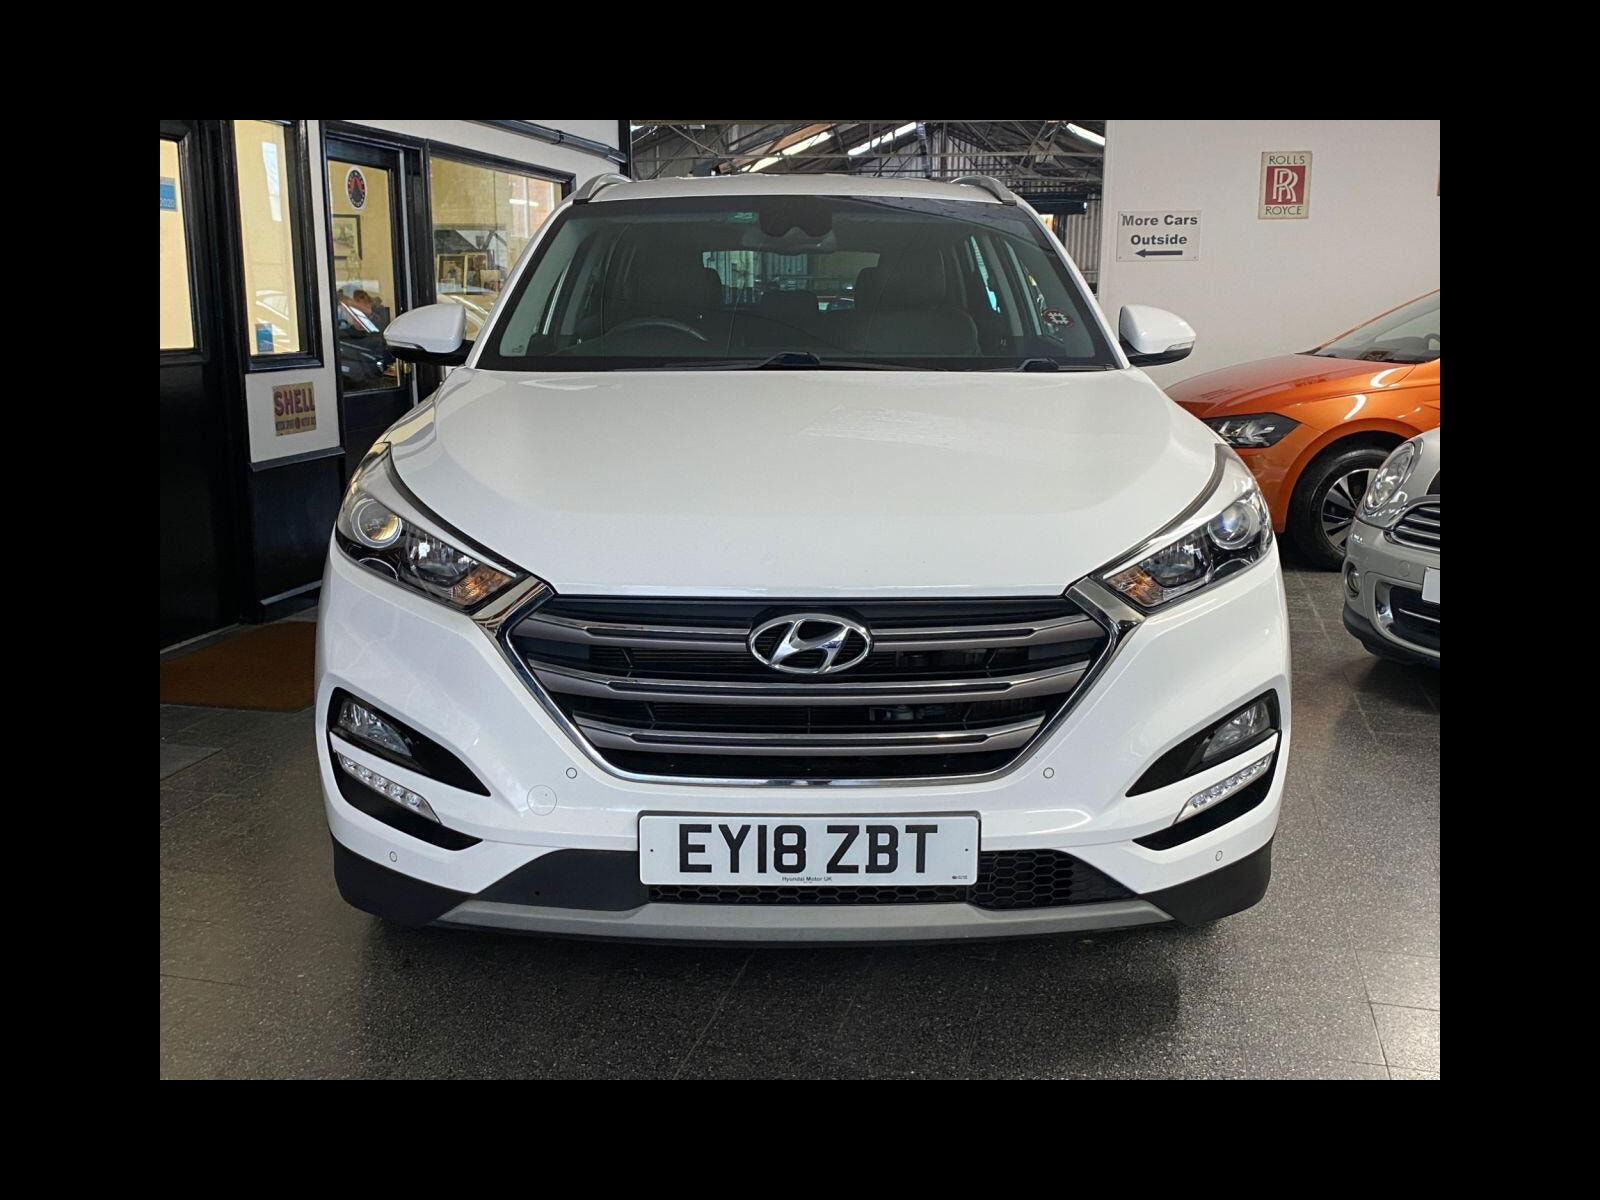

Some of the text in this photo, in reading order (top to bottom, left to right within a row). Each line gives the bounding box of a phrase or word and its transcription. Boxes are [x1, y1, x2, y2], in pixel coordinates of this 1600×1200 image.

[1268, 155, 1305, 165] ROLLS
[1265, 205, 1303, 215] ROYCE
[1122, 214, 1198, 226] More Cars
[1130, 234, 1188, 245] Outside
[273, 388, 316, 416] SHELL
[679, 824, 938, 874] EY18 ZBT
